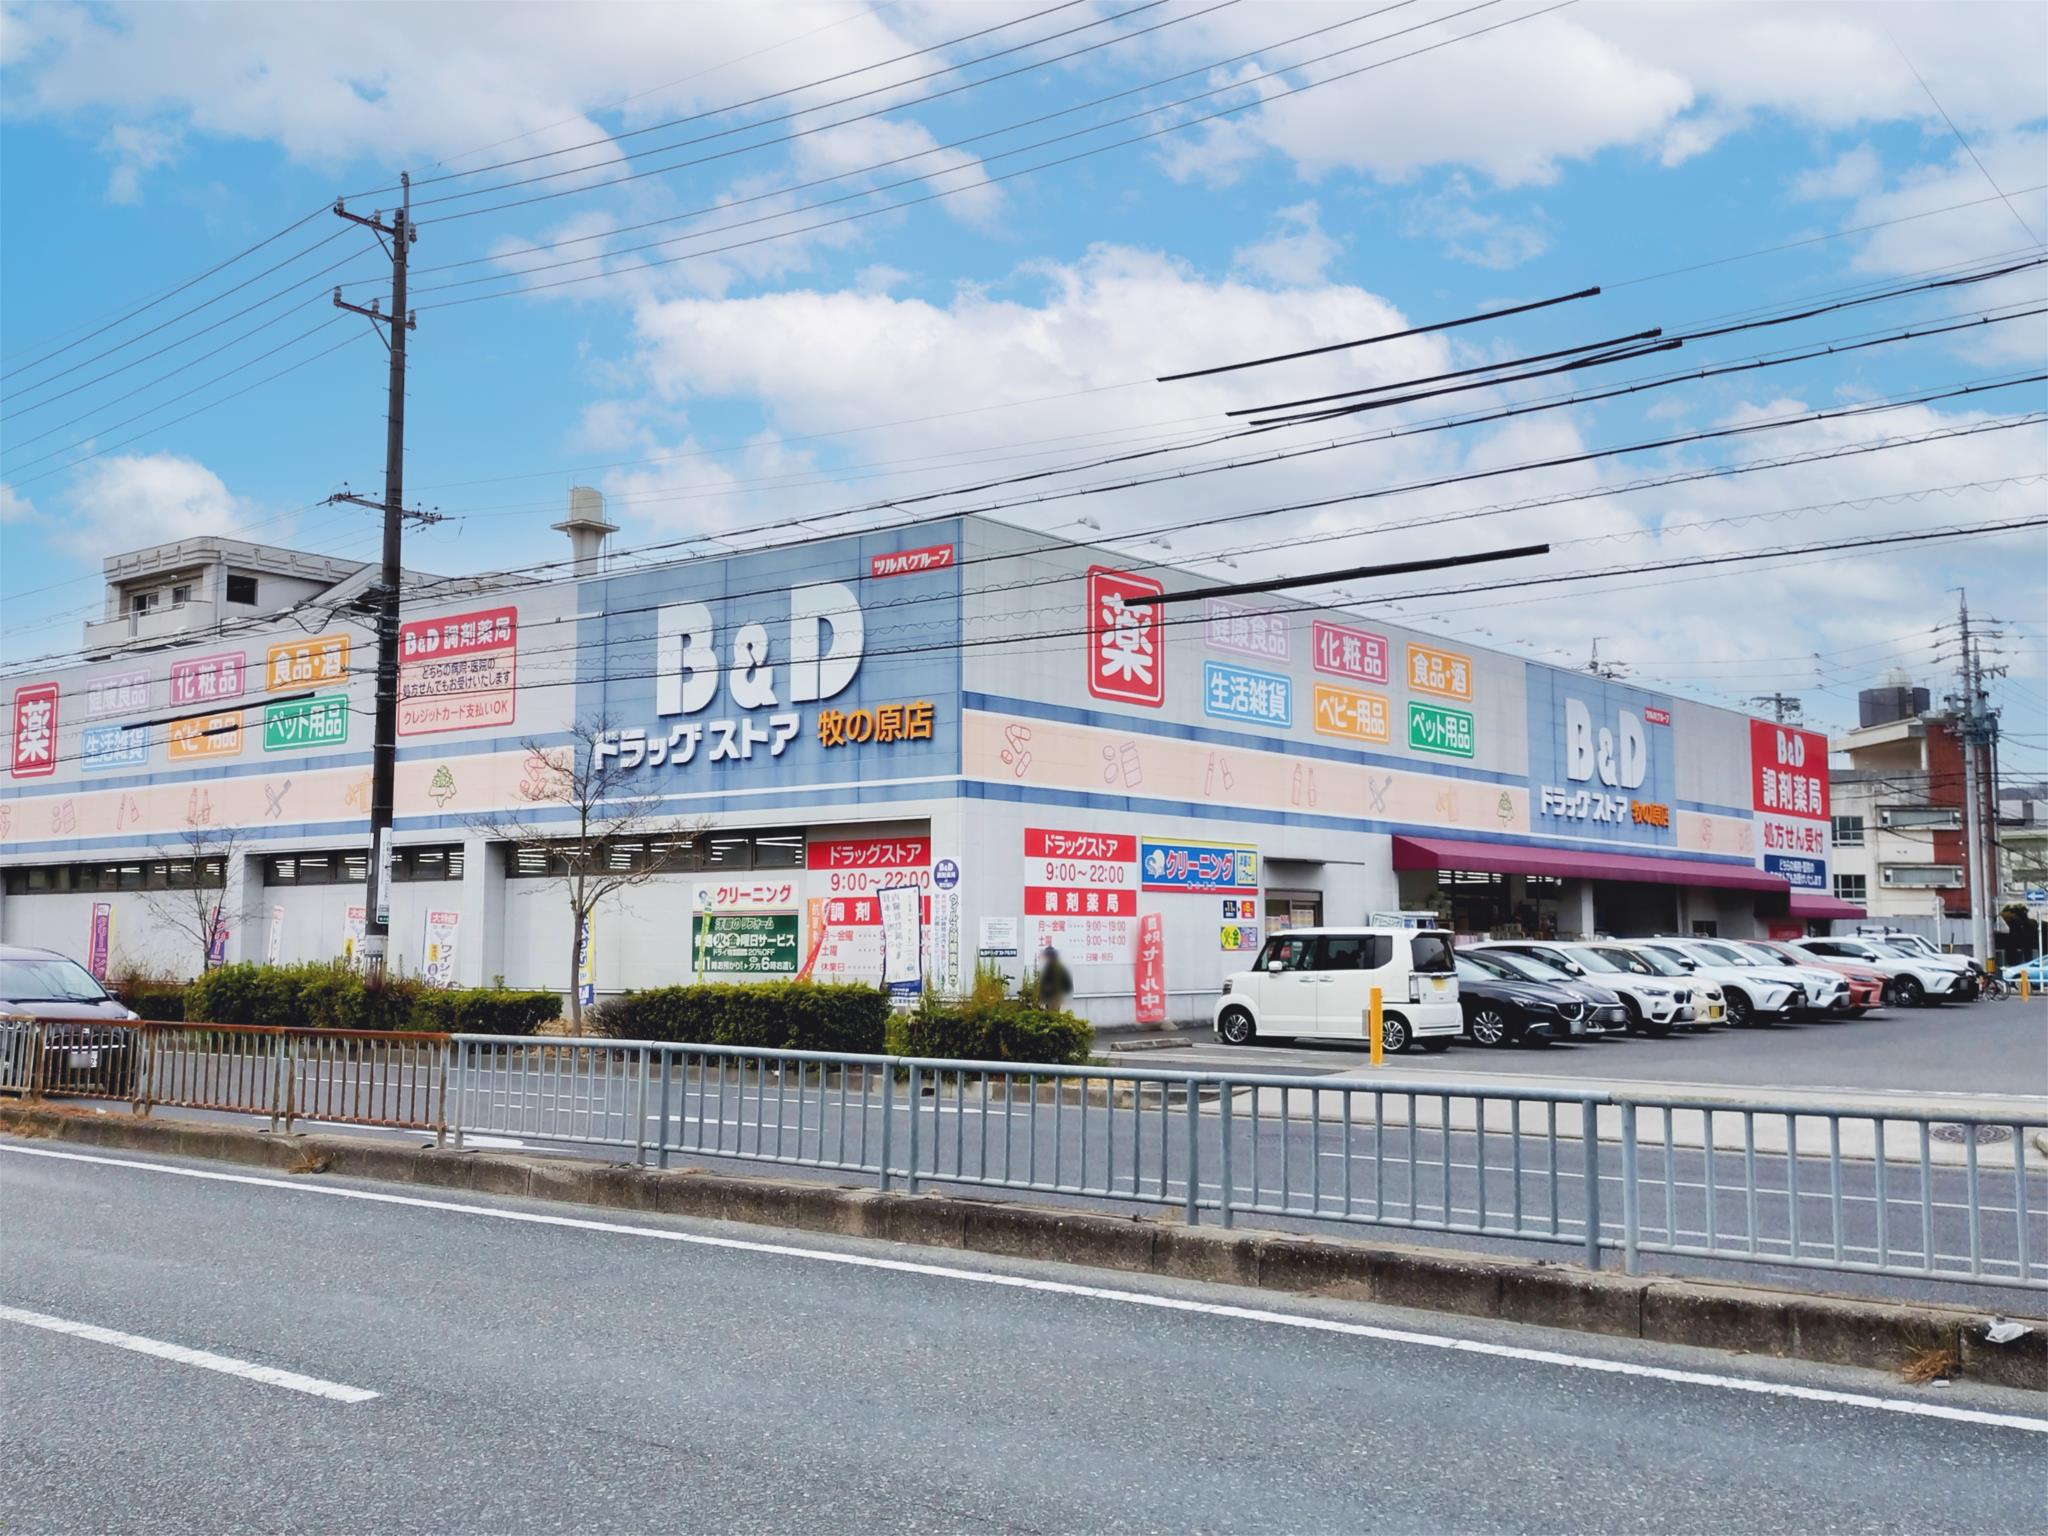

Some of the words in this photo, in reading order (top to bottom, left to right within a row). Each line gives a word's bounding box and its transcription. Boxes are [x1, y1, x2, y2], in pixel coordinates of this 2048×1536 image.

[405, 628, 440, 656] B&D
[443, 616, 511, 650] 調剤薬局
[1101, 592, 1153, 685] 薬
[1212, 603, 1286, 655] 健康食品
[655, 581, 864, 717] B&D
[1321, 631, 1382, 676] 化粧品
[177, 661, 237, 700] 化粧品
[1413, 653, 1467, 693] 食品・酒
[404, 700, 509, 725] クレジットカード支払いOK
[1211, 672, 1286, 720] 生活雑貨
[18, 700, 51, 762] 薬
[174, 717, 237, 751] ベビ用品
[269, 704, 342, 740] ペット用品
[595, 713, 799, 770] ドラッグストア
[817, 701, 934, 748] 牧の原店
[1320, 696, 1385, 736] ベビー用品
[1413, 712, 1471, 750] ペット用品
[1565, 697, 1647, 790] B&D
[1776, 730, 1805, 768] B&D
[1540, 785, 1628, 824] ドラッグストア
[1762, 767, 1822, 816] 調剤薬局
[830, 844, 922, 866] ドラッグストア
[1045, 834, 1118, 858] ドラッグストア
[1764, 821, 1823, 854] 処方せん受付
[1166, 850, 1234, 882] クリーニング
[717, 885, 792, 904] クリーニング
[1045, 891, 1119, 913] 調剤薬局
